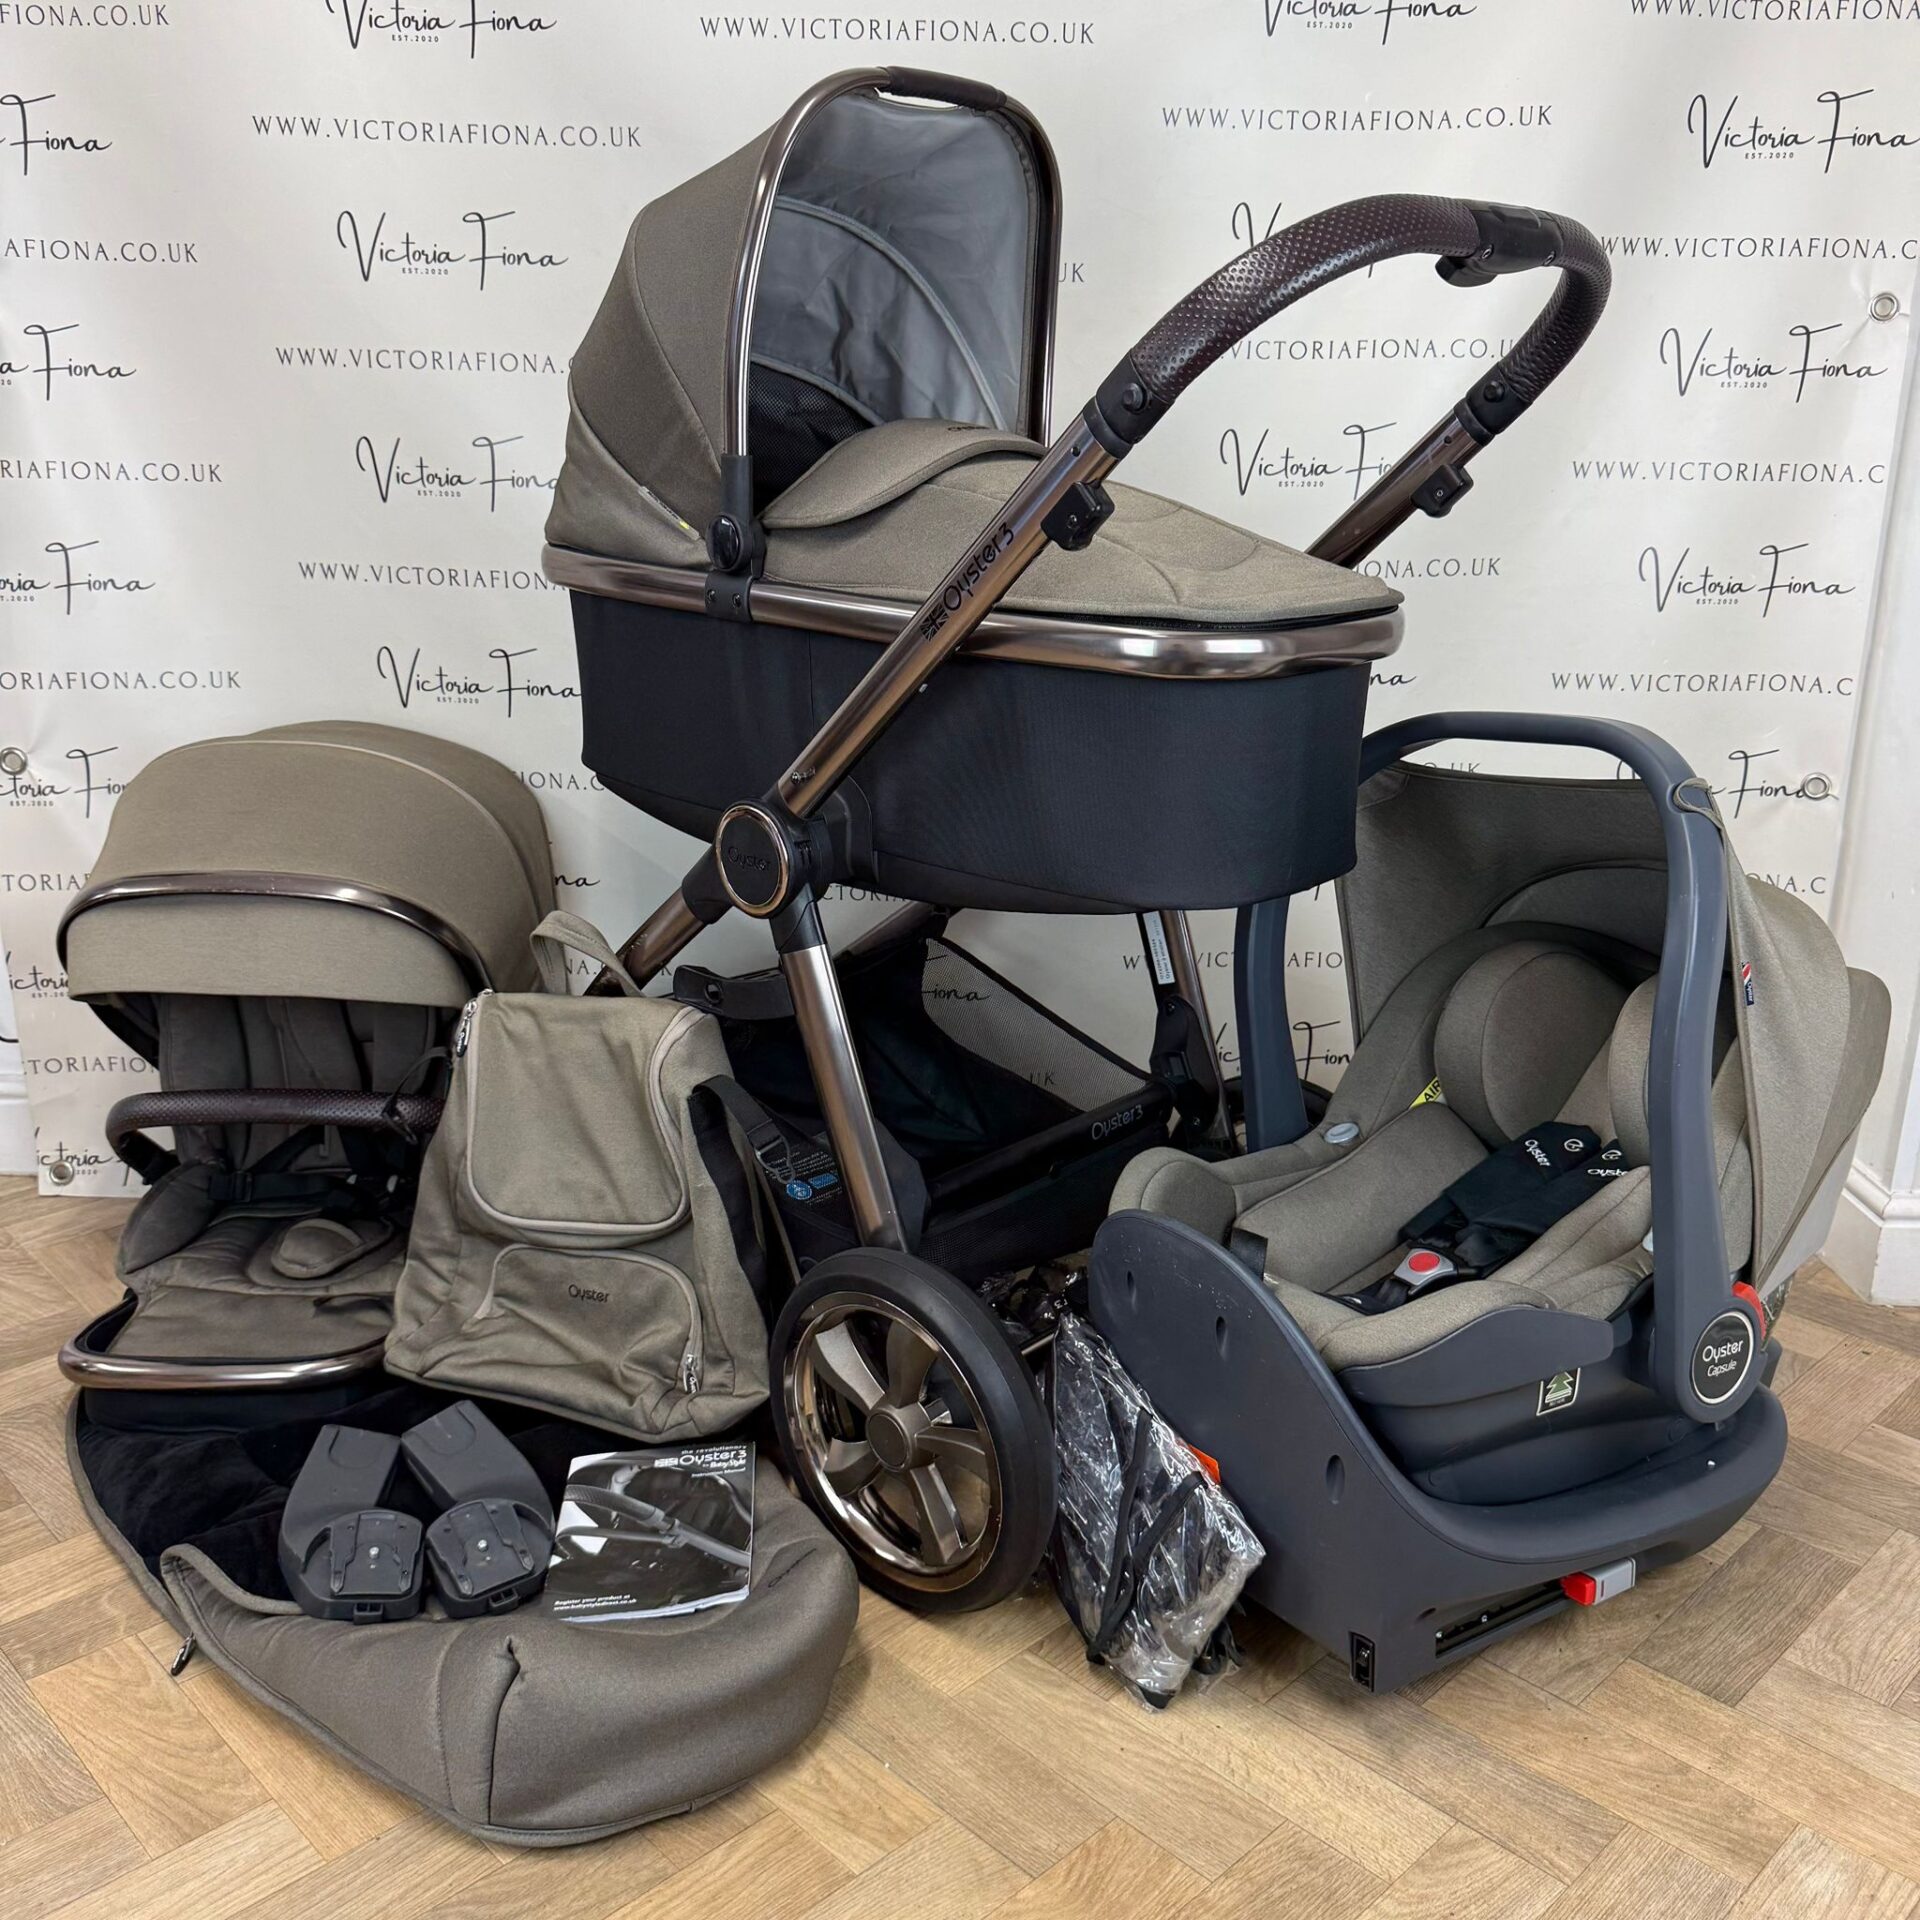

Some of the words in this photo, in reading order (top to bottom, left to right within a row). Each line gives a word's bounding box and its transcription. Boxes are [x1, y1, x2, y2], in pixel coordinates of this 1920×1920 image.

[325, 0, 456, 49] Victoria
[459, 0, 557, 59] Fiona
[391, 34, 439, 42] EST.2020
[700, 16, 1094, 44] WWW.VICTORIAFIONA.CO.UK
[1306, 21, 1353, 29] EST.2020
[0, 94, 112, 175] Fiona
[252, 114, 641, 148] WWW.VICTORIAFIONA.CO.UK
[1161, 104, 1553, 131] WWW.VICTORIAFIONA.CO.UK
[1687, 94, 1815, 168] Victoria
[1817, 89, 1920, 173] Fiona
[1744, 152, 1794, 160] EST.2020
[337, 210, 465, 282] Victoria
[463, 210, 568, 290] Fiona
[402, 267, 449, 275] EST.2020
[24, 323, 137, 401] Fiona
[275, 346, 573, 374] WWW.VICTORIAFIONA.
[1660, 327, 1788, 397] Victoria
[1788, 323, 1888, 403] Fiona
[356, 436, 476, 503] Victoria
[1220, 428, 1343, 496] Victoria
[1278, 480, 1324, 488] EST.2020
[45, 540, 156, 615] Fiona
[1638, 546, 1757, 612] Victoria
[1757, 543, 1856, 618] Fiona
[377, 646, 494, 708] Victoria
[489, 648, 582, 718] Fiona
[568, 1284, 610, 1303] Oyster
[1702, 1340, 1744, 1363] Oyster
[1707, 1359, 1737, 1377] Capsule
